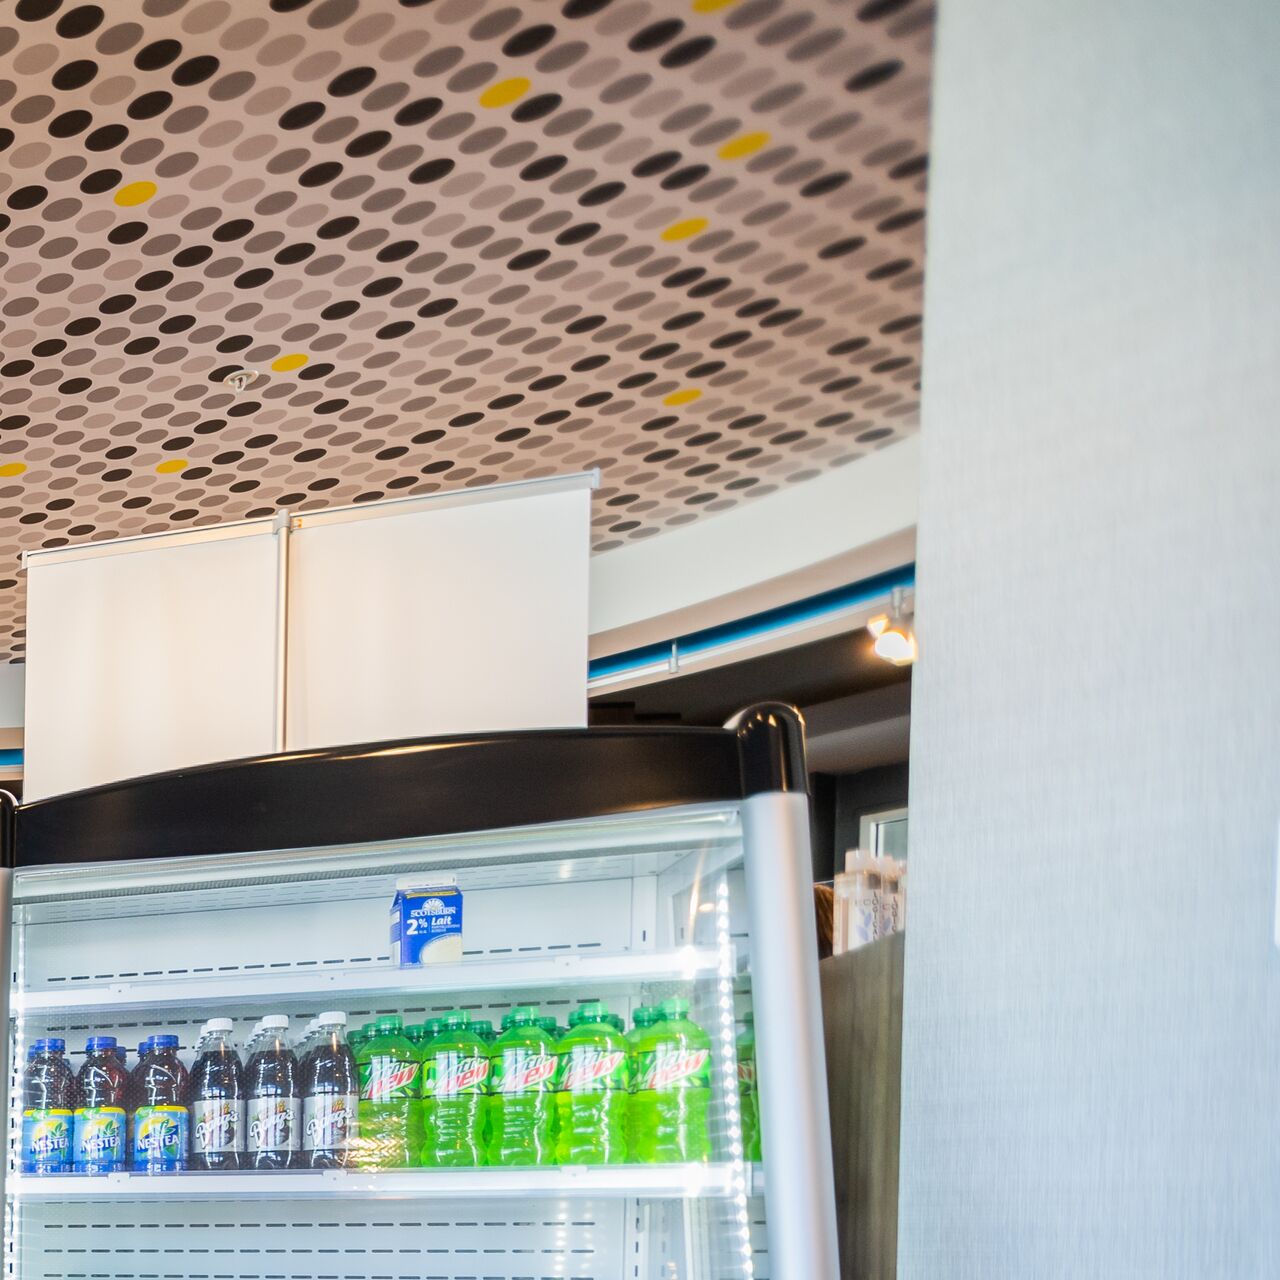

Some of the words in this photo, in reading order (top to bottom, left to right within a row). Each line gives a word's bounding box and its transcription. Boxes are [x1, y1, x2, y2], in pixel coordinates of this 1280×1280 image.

[406, 918, 428, 935] 2%
[431, 915, 452, 926] Lait
[31, 1136, 69, 1152] NESTEA
[81, 1136, 121, 1152] NESTEA
[137, 1134, 180, 1151] NESTEA
